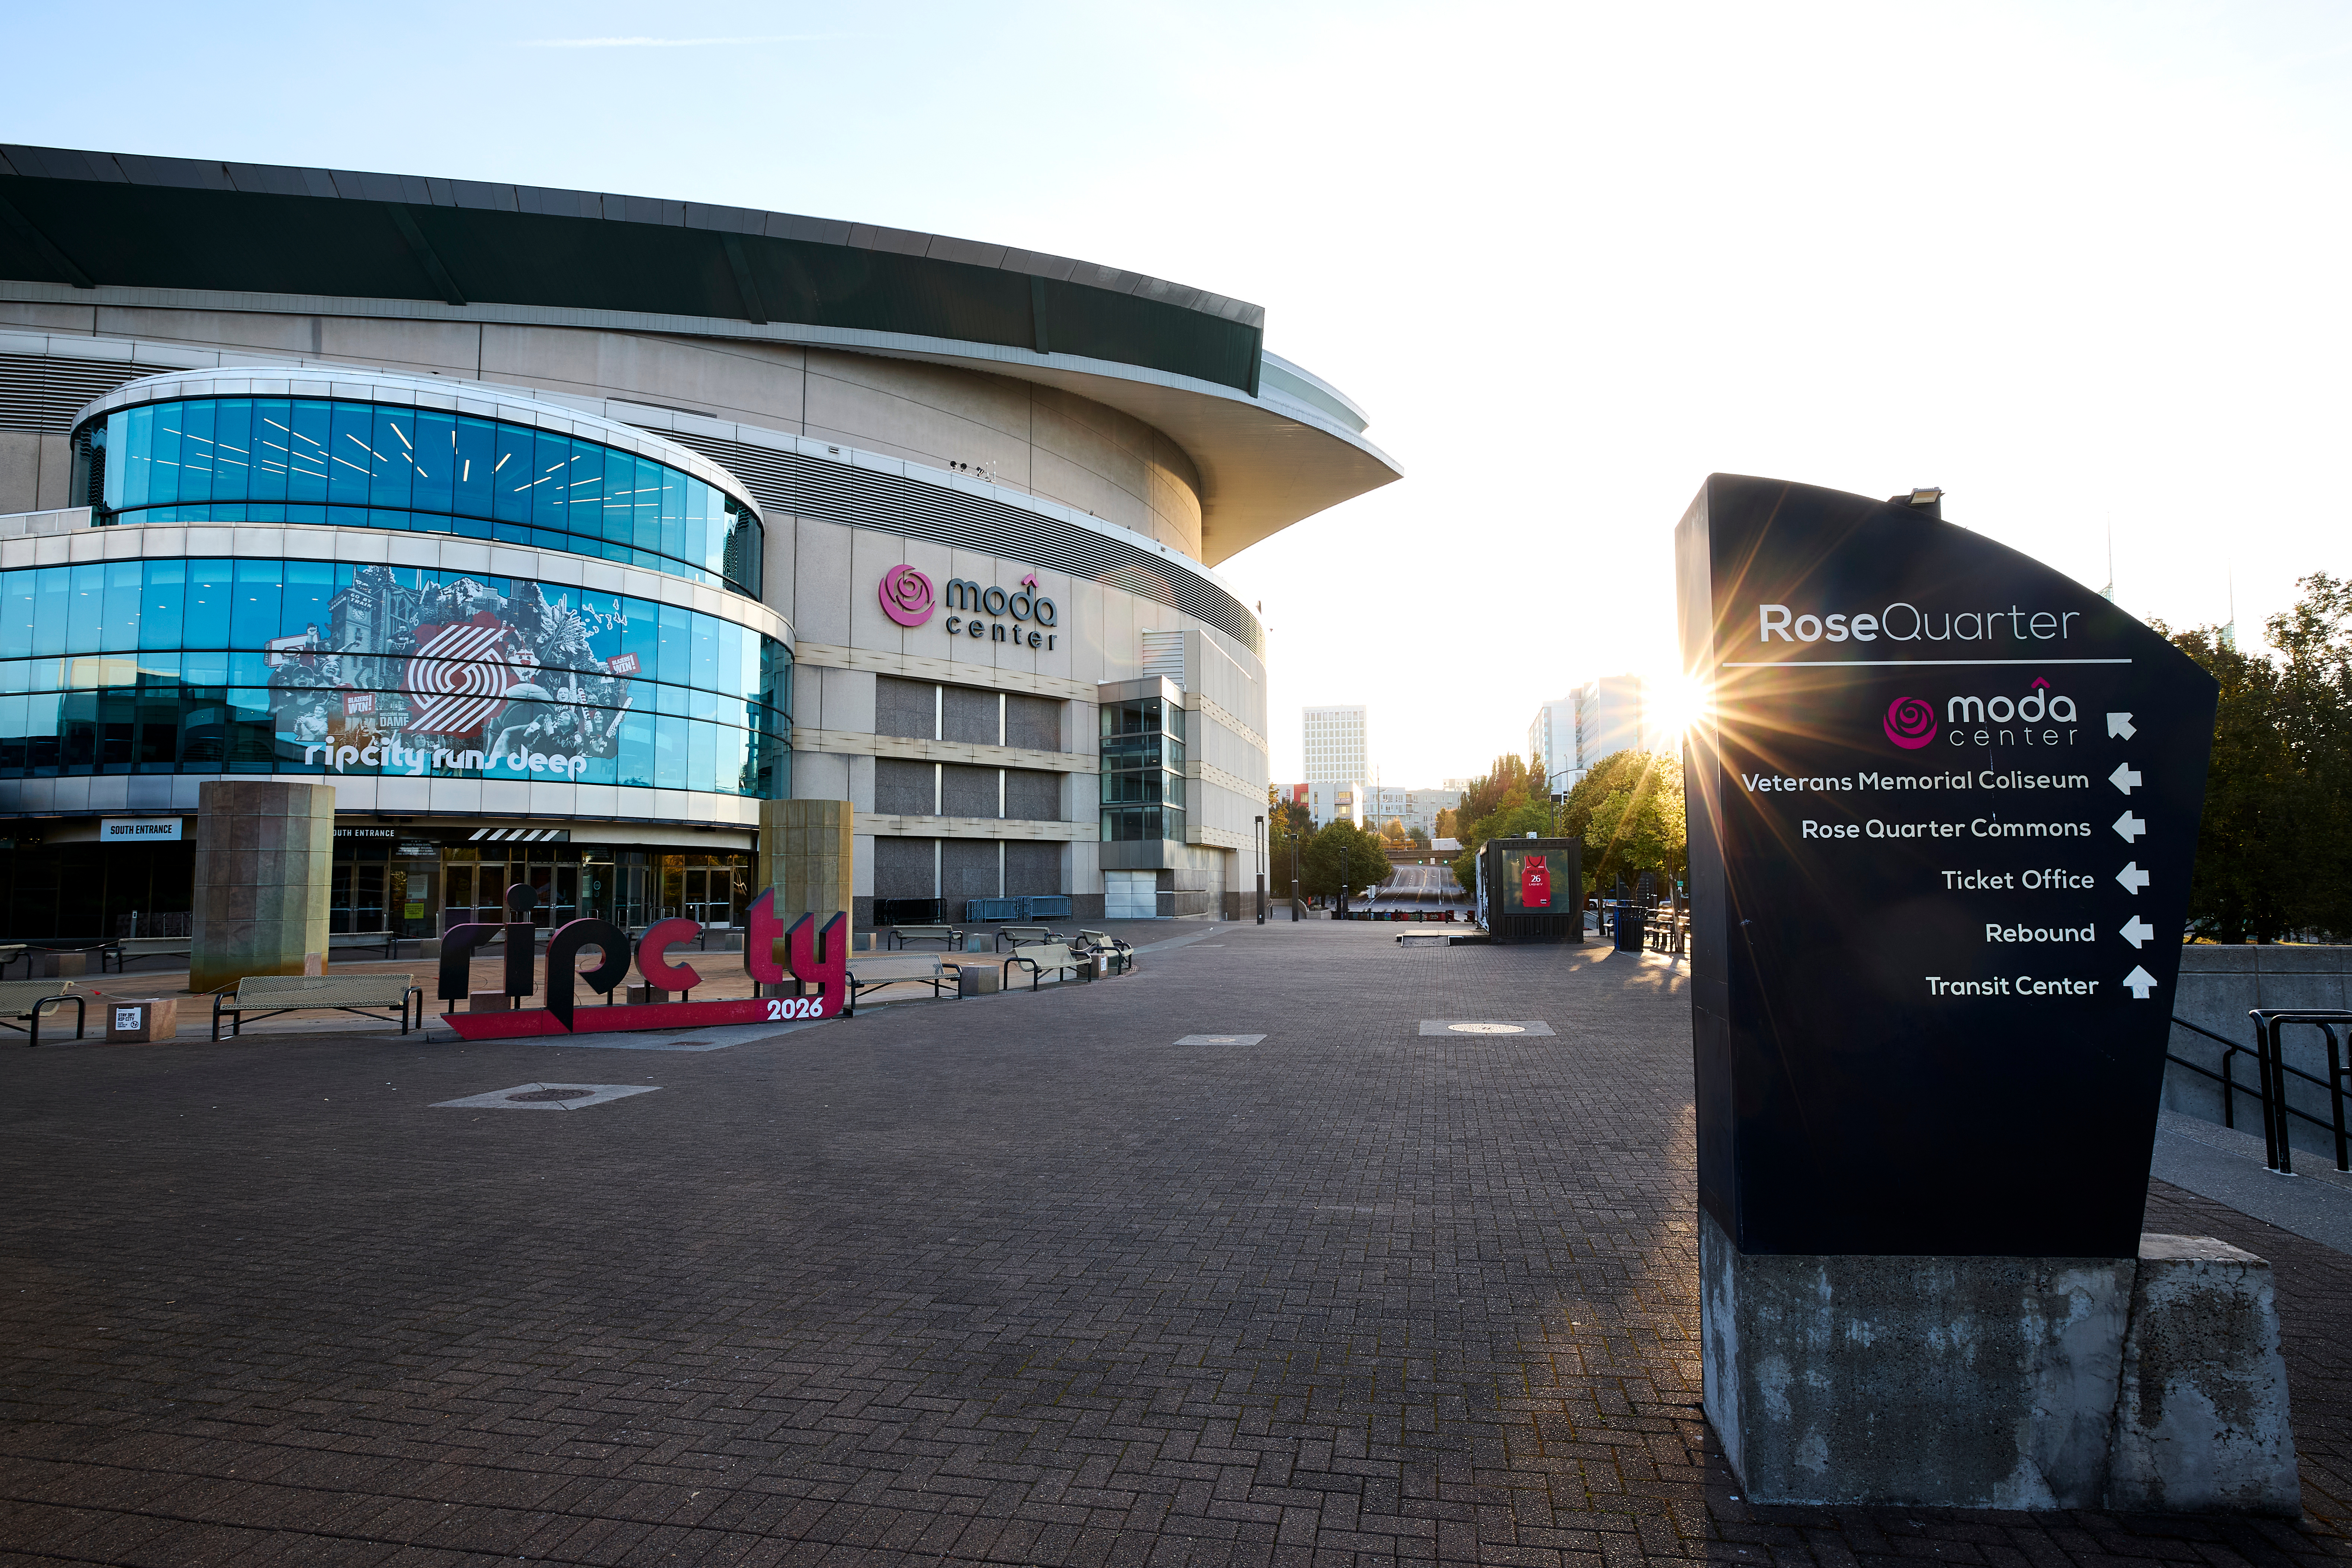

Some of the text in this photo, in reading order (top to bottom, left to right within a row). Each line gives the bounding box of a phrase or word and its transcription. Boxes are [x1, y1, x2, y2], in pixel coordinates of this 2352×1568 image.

[350, 597, 372, 608] TRAIN
[946, 574, 1057, 627] moda
[946, 616, 1057, 651] center
[612, 656, 630, 666] BLAZERS
[348, 695, 369, 704] BLAZERS
[1948, 687, 2077, 722] moda
[380, 716, 409, 727] DAME
[1950, 727, 2078, 746] center
[507, 744, 587, 782] deep
[1741, 771, 2089, 792] Veterans Memorial Coliseum
[110, 824, 172, 835] SOUTH ENTRANCE
[1802, 818, 2091, 838] Rose Quarter Commons
[1942, 868, 2094, 889] Ticket Office
[1986, 923, 2095, 942] Rebound
[1926, 976, 2099, 995] Transit Center
[767, 997, 823, 1020] 2026
